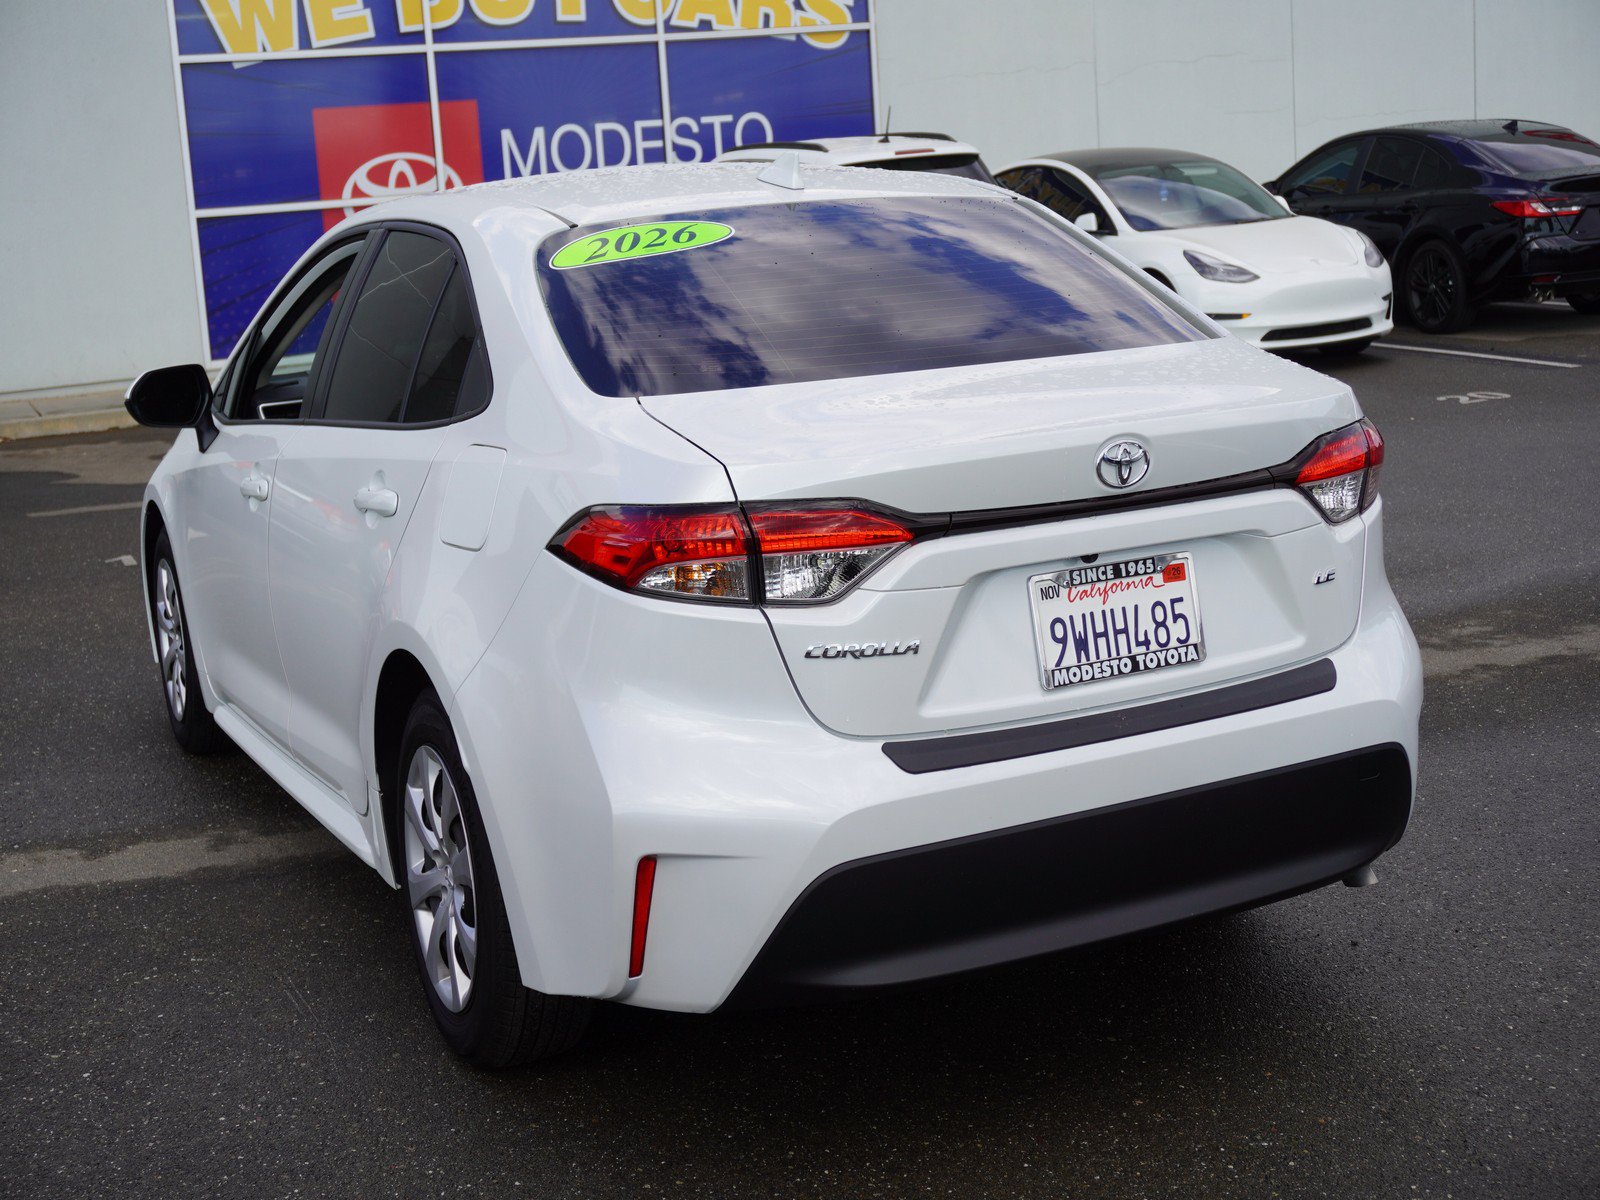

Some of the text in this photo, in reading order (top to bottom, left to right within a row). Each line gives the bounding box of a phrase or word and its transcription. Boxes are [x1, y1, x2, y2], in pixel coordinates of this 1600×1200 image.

[500, 112, 774, 180] MODESTO
[583, 223, 699, 263] 2026
[1436, 391, 1511, 404] 20
[1072, 558, 1155, 585] SINCE 1965
[1314, 568, 1336, 585] LE
[1040, 585, 1061, 601] NOV
[1067, 576, 1165, 605] California
[1050, 596, 1191, 668] 9WHH485
[804, 640, 920, 659] COROLLA
[1054, 645, 1199, 687] MODESTO TOYOTA
